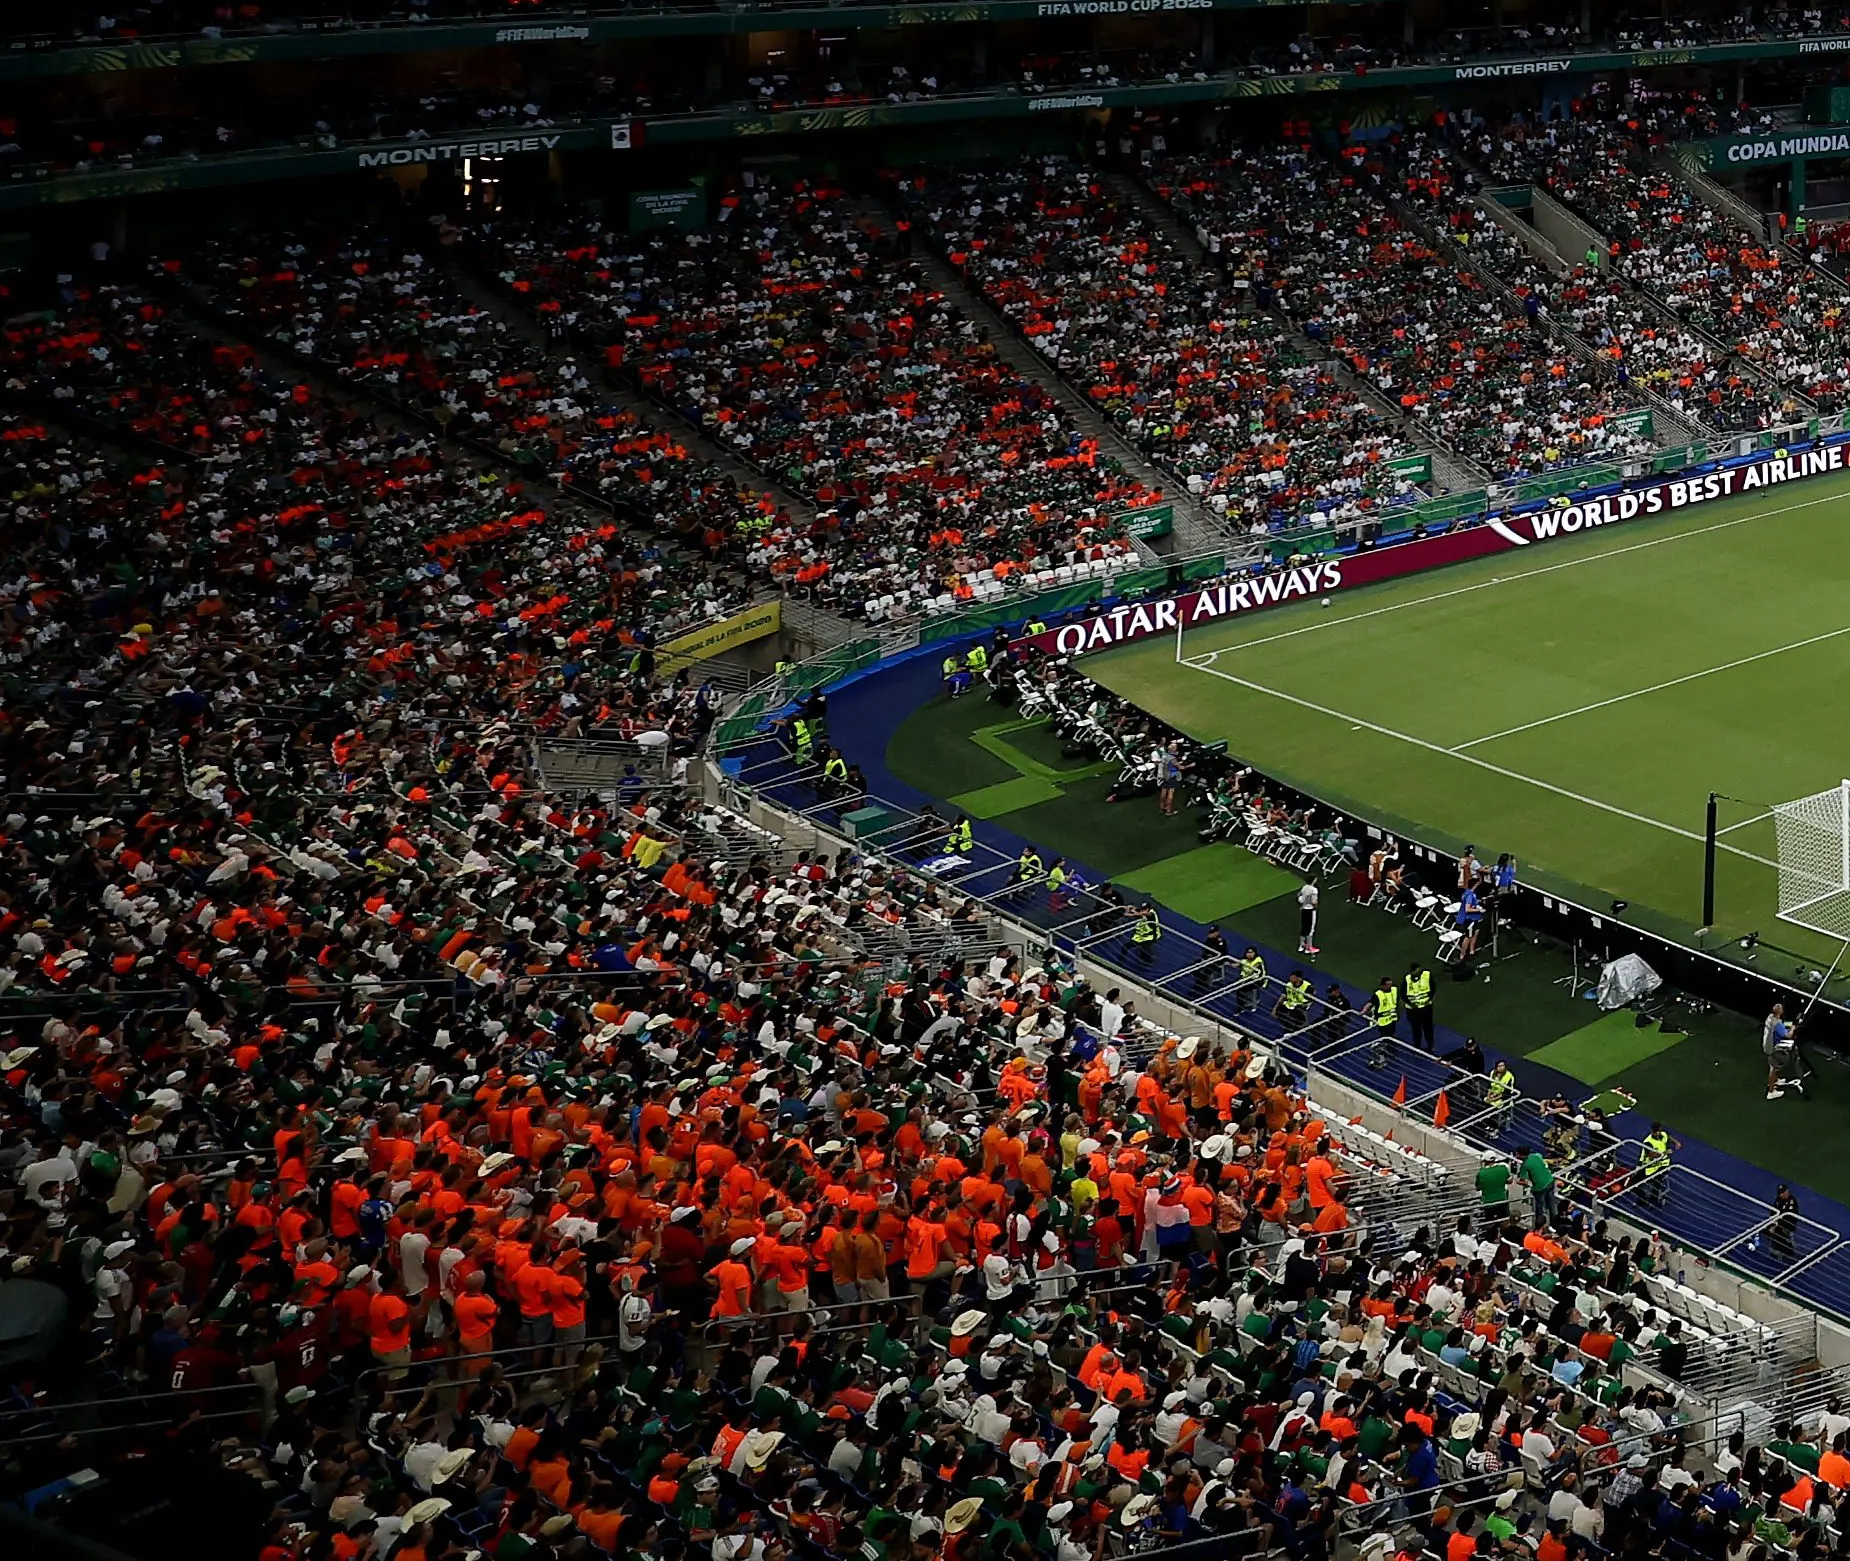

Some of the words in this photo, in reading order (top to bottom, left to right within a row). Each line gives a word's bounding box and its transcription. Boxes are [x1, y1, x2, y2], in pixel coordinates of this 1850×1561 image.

[1038, 3, 1071, 16] FIFA
[1073, 0, 1129, 14] WORLD
[1799, 43, 1821, 53] FIFA
[1456, 60, 1571, 79] MONTERREY
[359, 136, 560, 167] MONTERREY
[1728, 141, 1778, 162] COPA
[1531, 488, 1662, 539] WORLD'S
[1670, 470, 1735, 508] BEST
[1742, 446, 1843, 490] AIRLINE
[1056, 598, 1179, 657] QATAR
[1191, 560, 1342, 621] AIRWAYS
